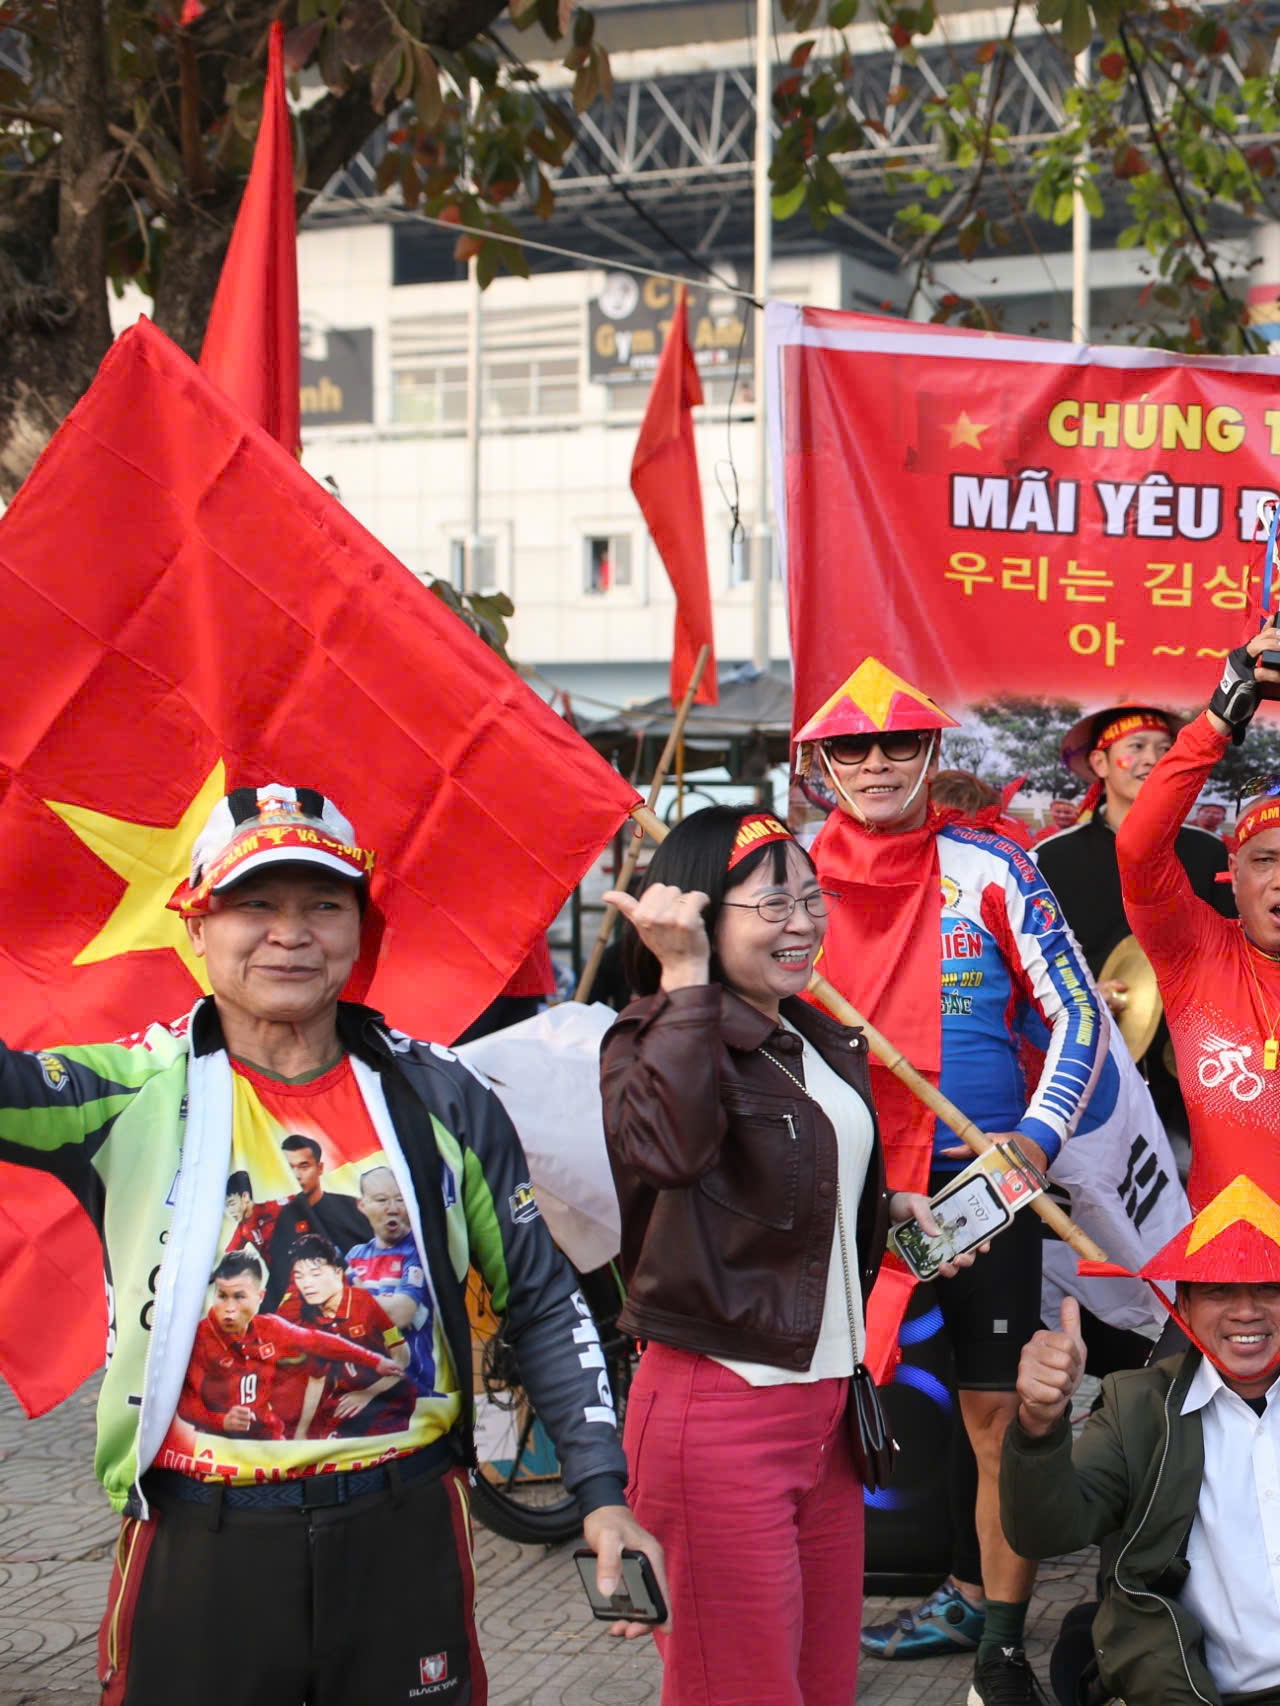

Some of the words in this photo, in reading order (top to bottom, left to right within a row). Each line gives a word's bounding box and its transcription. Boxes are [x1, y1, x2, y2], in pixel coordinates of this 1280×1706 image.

[1048, 392, 1247, 453] CHÚNG
[952, 468, 1078, 535] MÃI
[1096, 473, 1221, 541] YÊU
[944, 551, 1114, 603] 우리는
[1069, 621, 1125, 667] 아
[941, 920, 983, 961] IỀN
[966, 1194, 989, 1223] 17:07
[240, 1373, 258, 1405] 19
